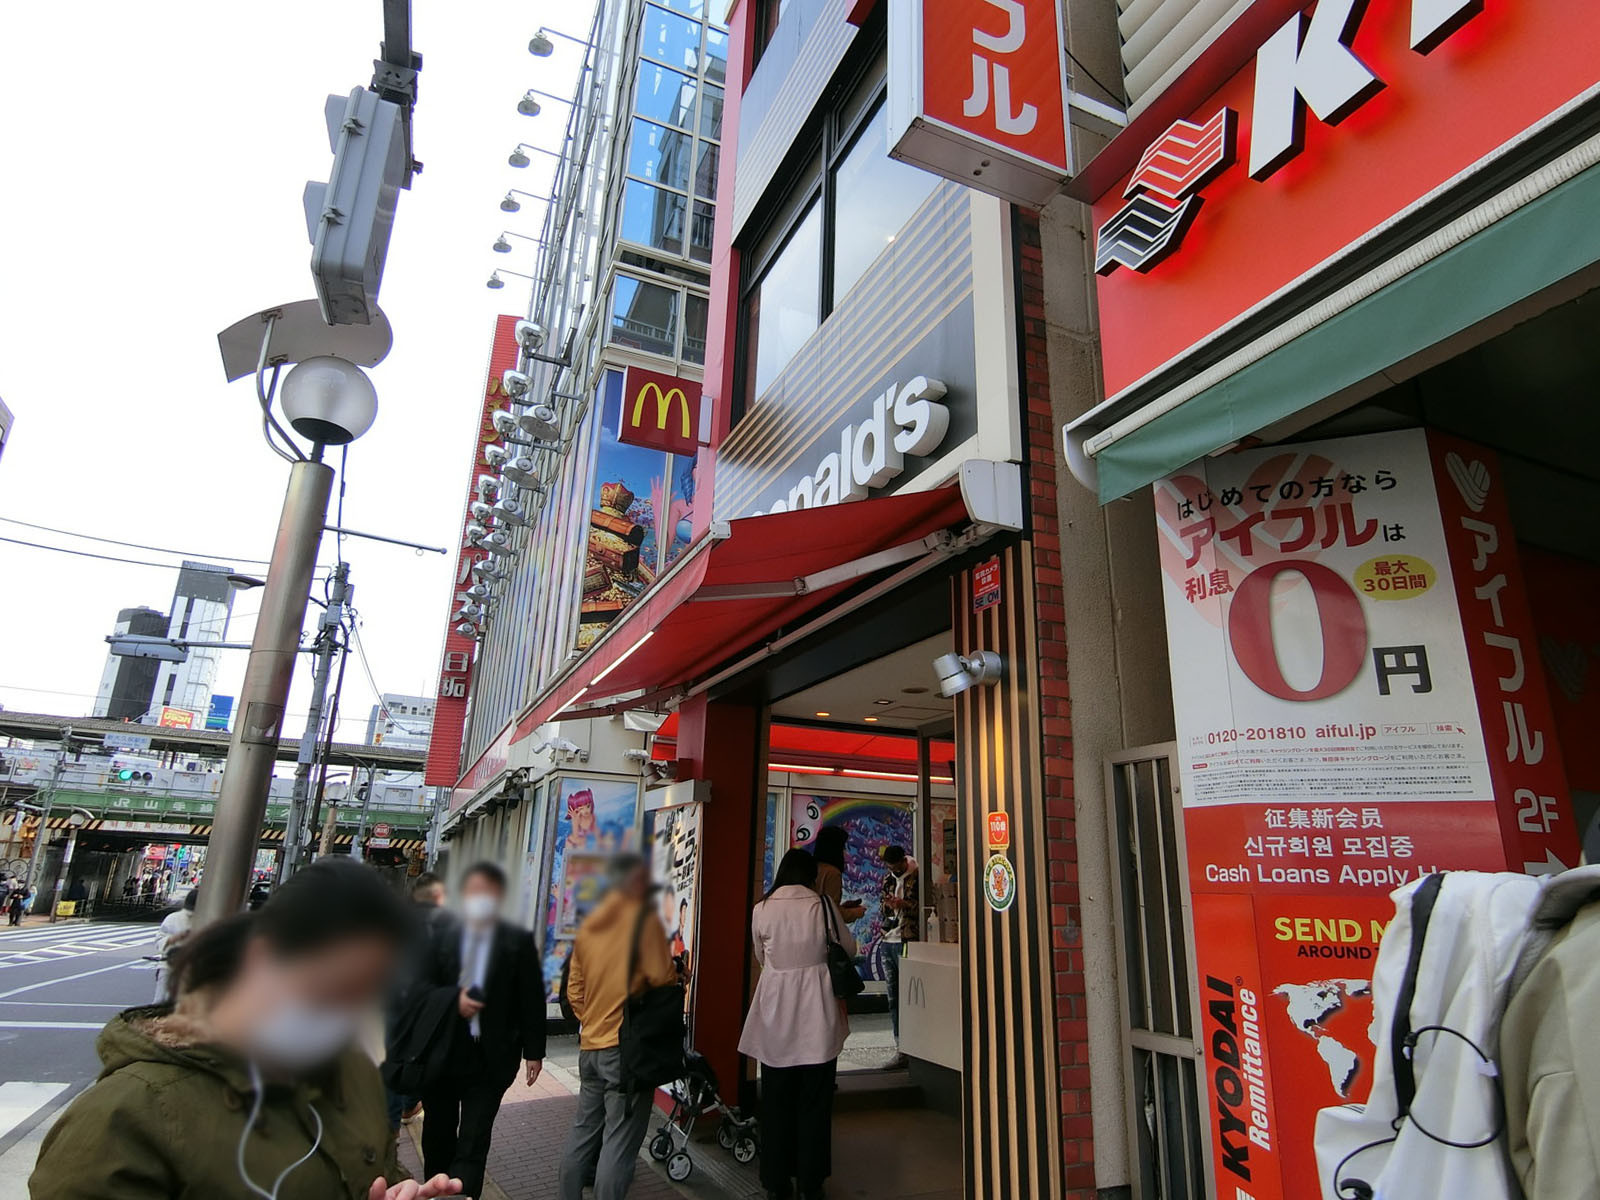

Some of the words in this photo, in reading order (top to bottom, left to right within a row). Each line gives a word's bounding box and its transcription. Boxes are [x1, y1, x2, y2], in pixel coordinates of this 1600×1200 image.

[751, 375, 948, 517] nald's
[1176, 469, 1398, 521] はじめての方なら
[1179, 502, 1379, 569] アイフル
[1382, 523, 1406, 542] は
[1374, 560, 1410, 575] 最大
[1184, 568, 1235, 603] 利息
[1363, 574, 1427, 592] 30日間
[1228, 559, 1368, 702] 0
[1372, 645, 1433, 695] 円
[1461, 517, 1544, 766] アイフル
[1206, 726, 1306, 745] 0120-201810
[1315, 723, 1376, 742] aiful.jp
[1384, 726, 1416, 734] アイフル
[1264, 808, 1383, 829] 征集新会员
[1514, 788, 1559, 833] 2F
[1244, 836, 1334, 858] 신규회원
[1342, 835, 1415, 858] 모집중
[1206, 865, 1250, 883] Cash
[1257, 865, 1330, 884] Loans
[1339, 865, 1409, 887] Apply
[1274, 917, 1363, 943] SEND
[1297, 945, 1372, 959] AROUND
[1206, 975, 1252, 1182] KYODAI
[1241, 988, 1272, 1152] Remittance
